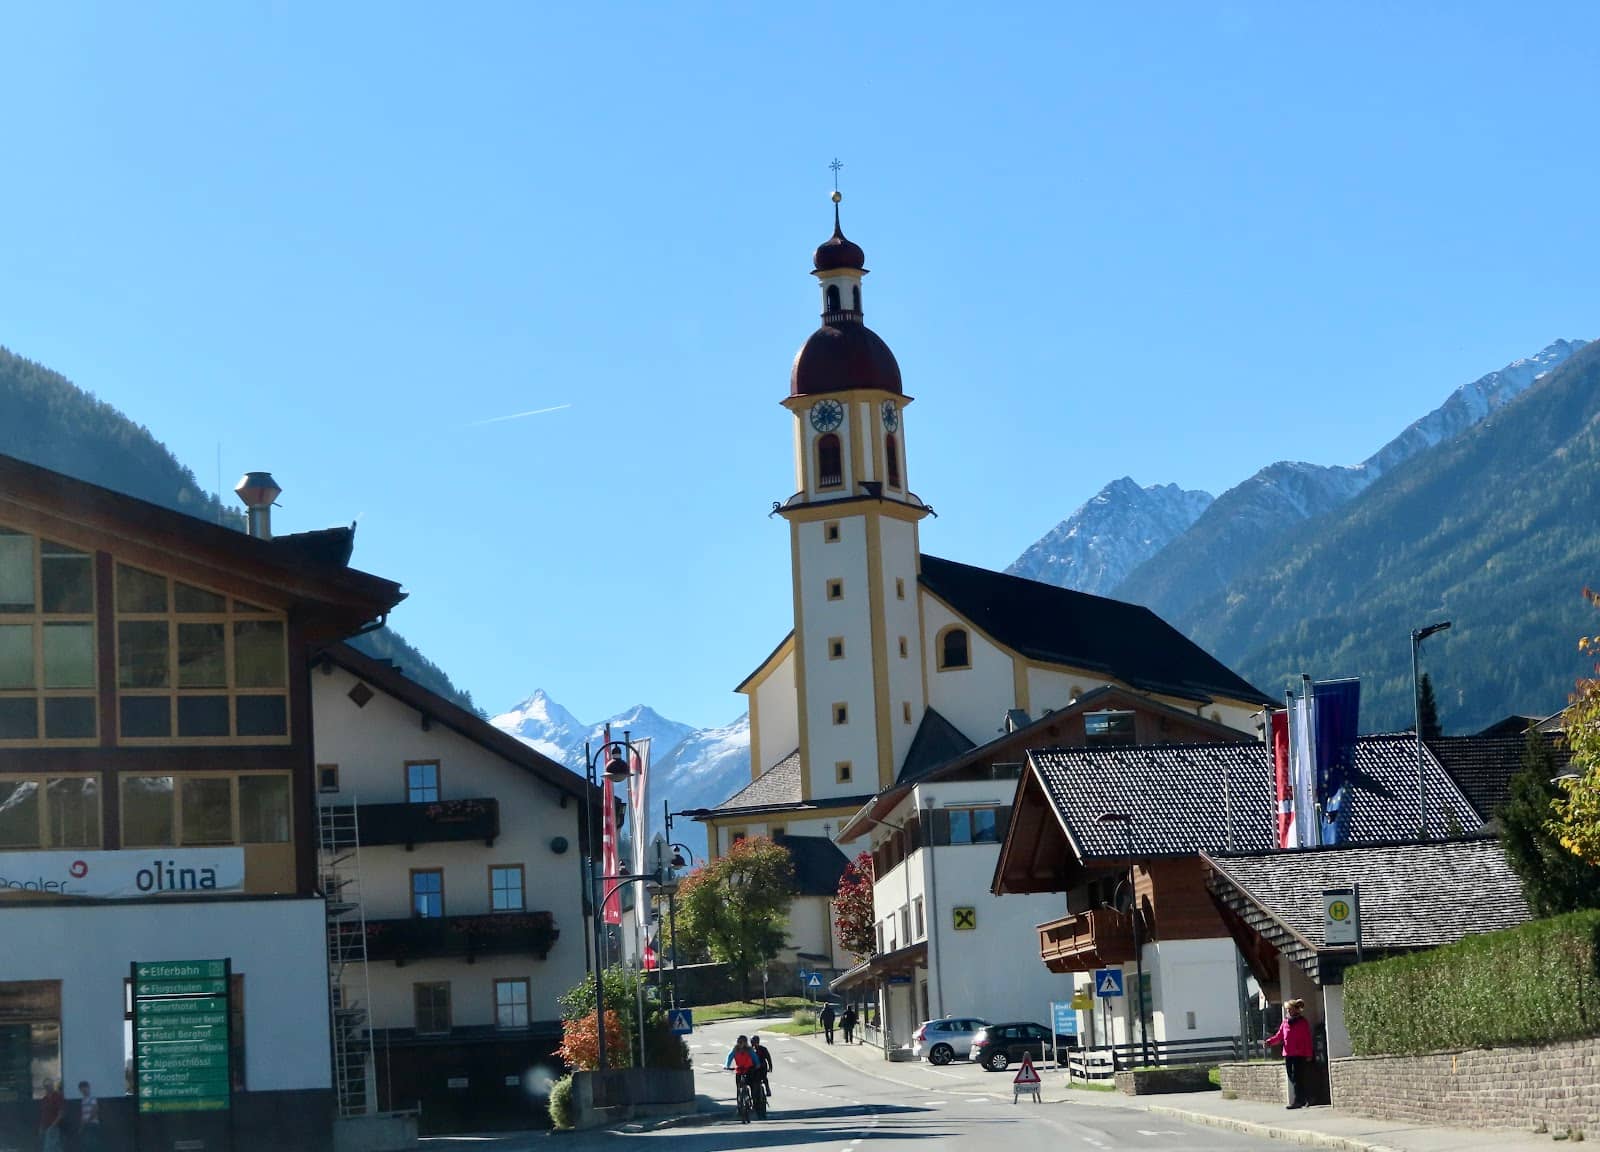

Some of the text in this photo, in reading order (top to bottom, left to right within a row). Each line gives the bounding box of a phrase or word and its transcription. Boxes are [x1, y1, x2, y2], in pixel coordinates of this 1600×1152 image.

[136, 860, 216, 891] olina
[1334, 904, 1344, 918] H
[151, 966, 200, 977] Elferbahn
[152, 1031, 176, 1040] Hotel
